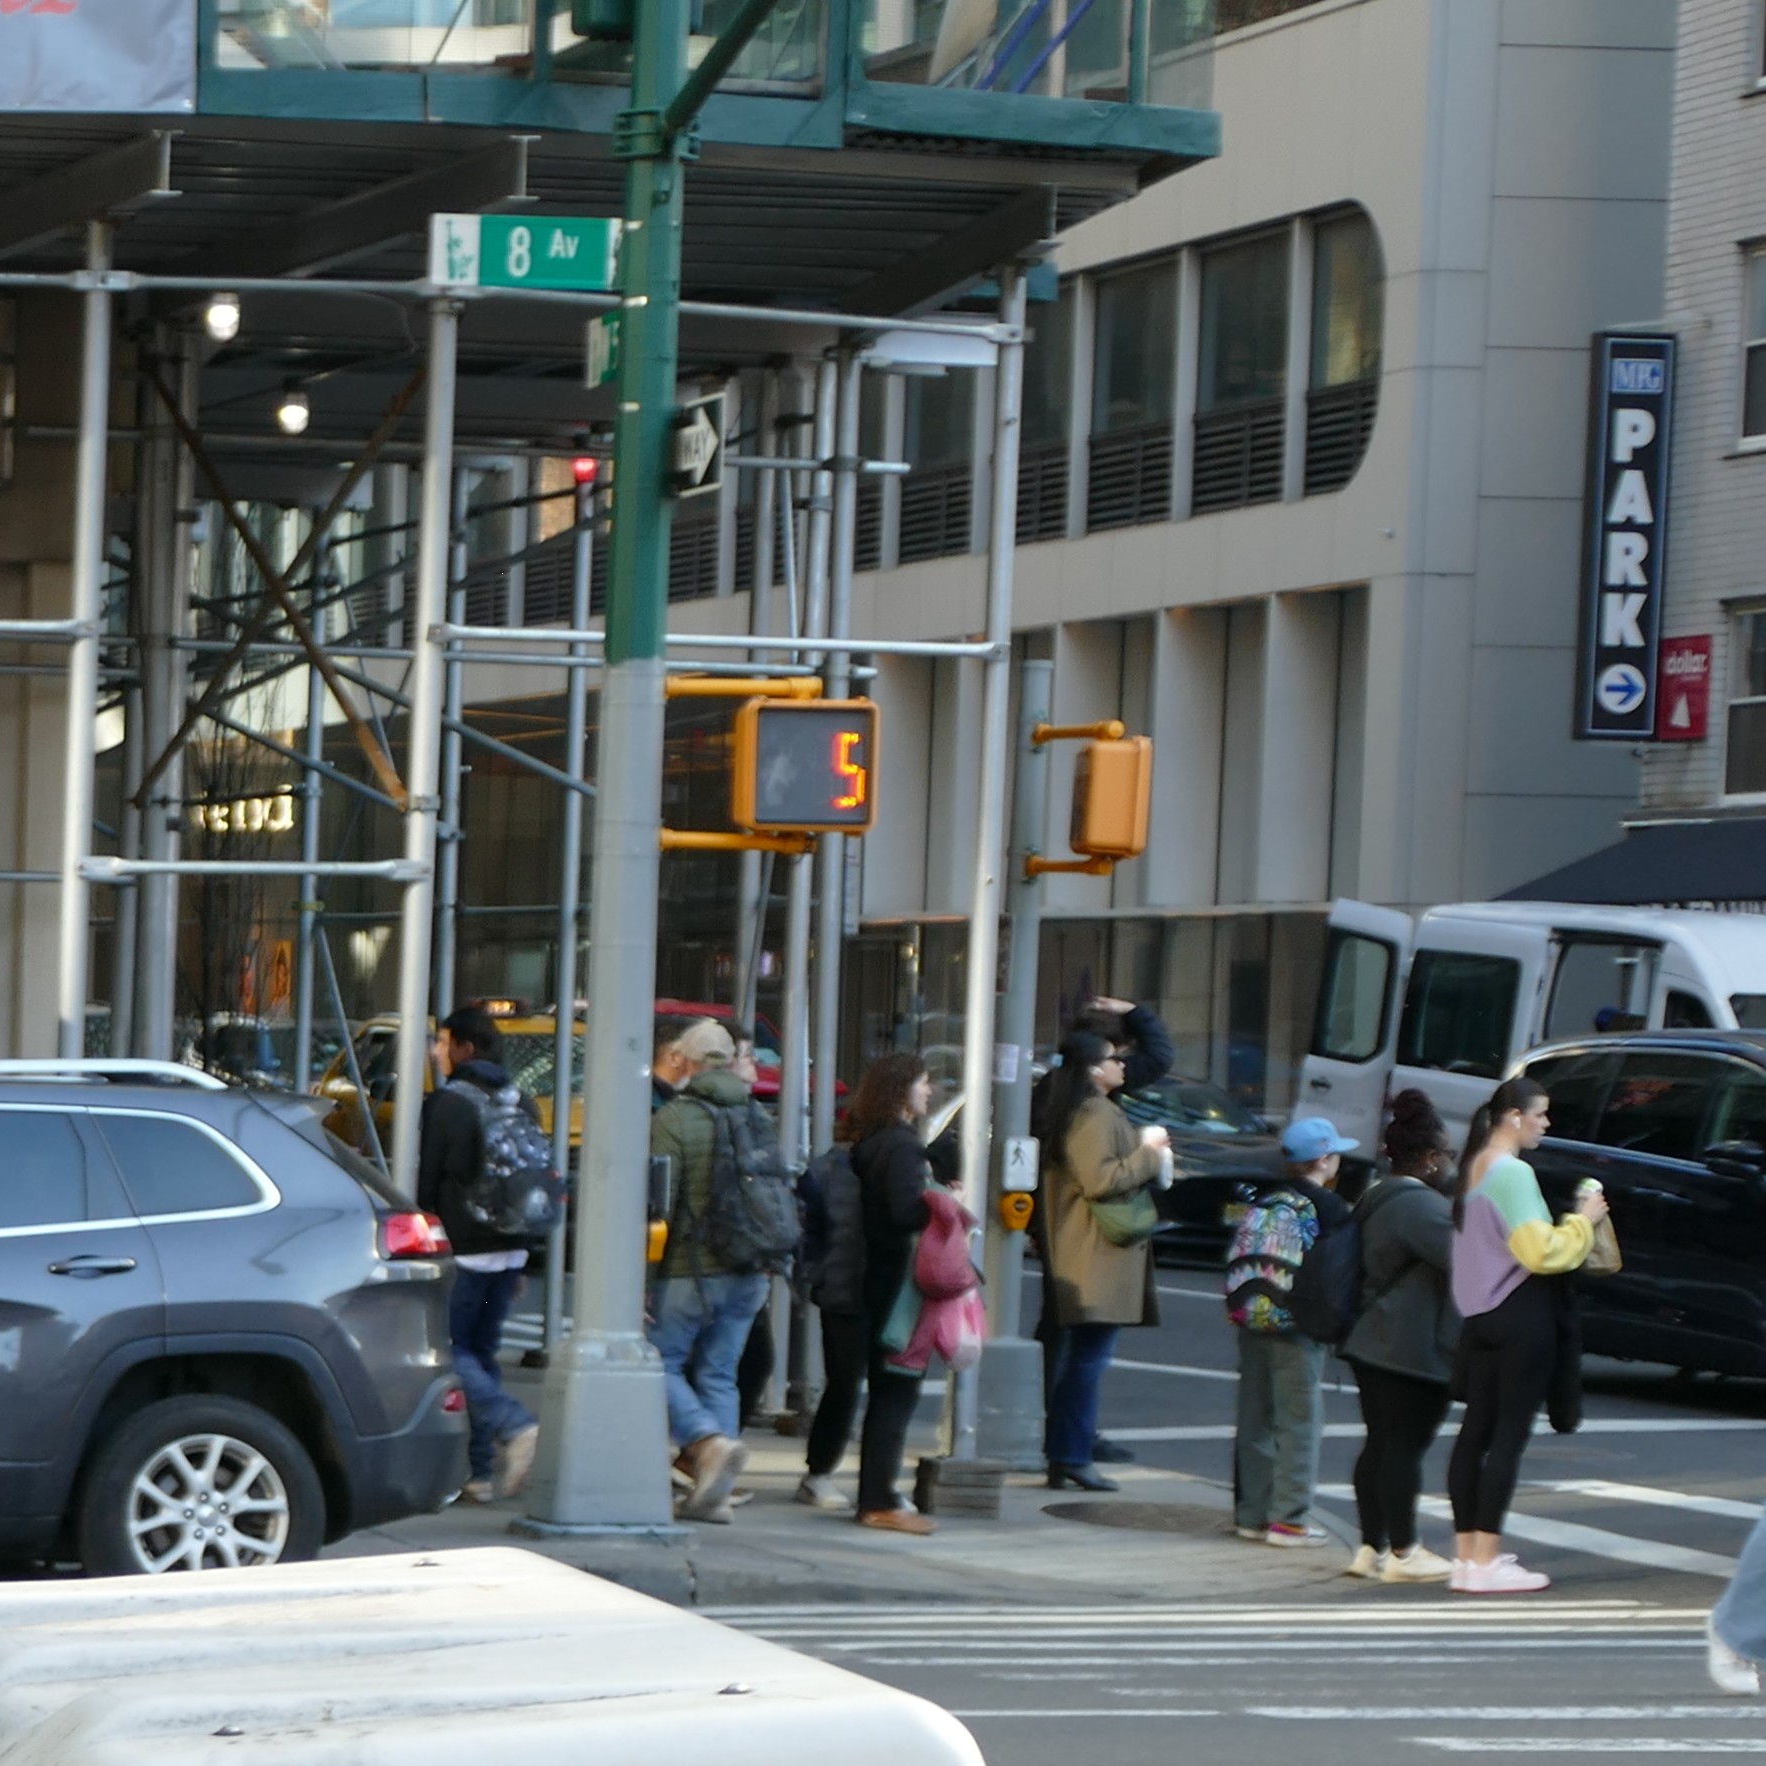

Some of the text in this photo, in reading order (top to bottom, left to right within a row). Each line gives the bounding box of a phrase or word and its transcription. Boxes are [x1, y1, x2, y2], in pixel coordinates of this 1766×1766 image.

[507, 226, 580, 278] 8 Av
[1601, 407, 1657, 648] PARK
[833, 731, 867, 810] 5
